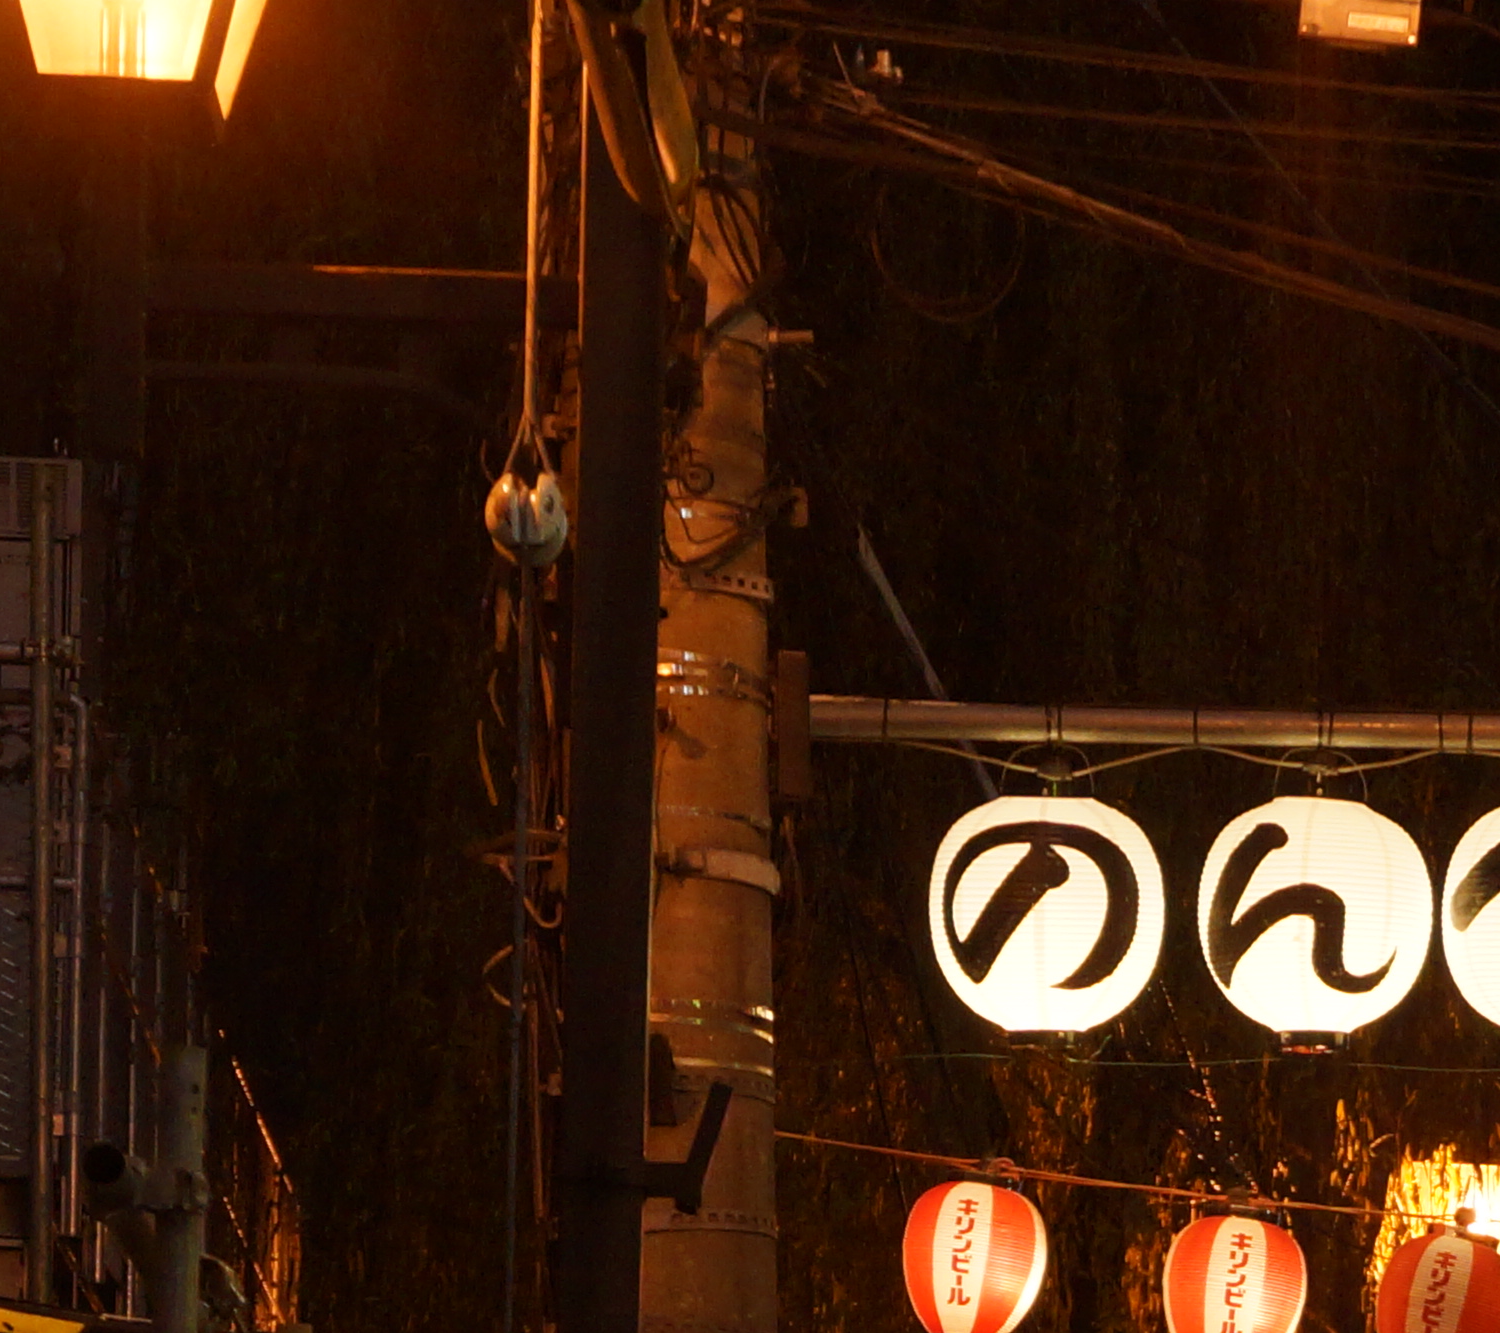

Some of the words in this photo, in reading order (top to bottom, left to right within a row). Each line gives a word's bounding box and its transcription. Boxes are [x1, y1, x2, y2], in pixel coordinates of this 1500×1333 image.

[949, 1199, 978, 1306] キリンビール
